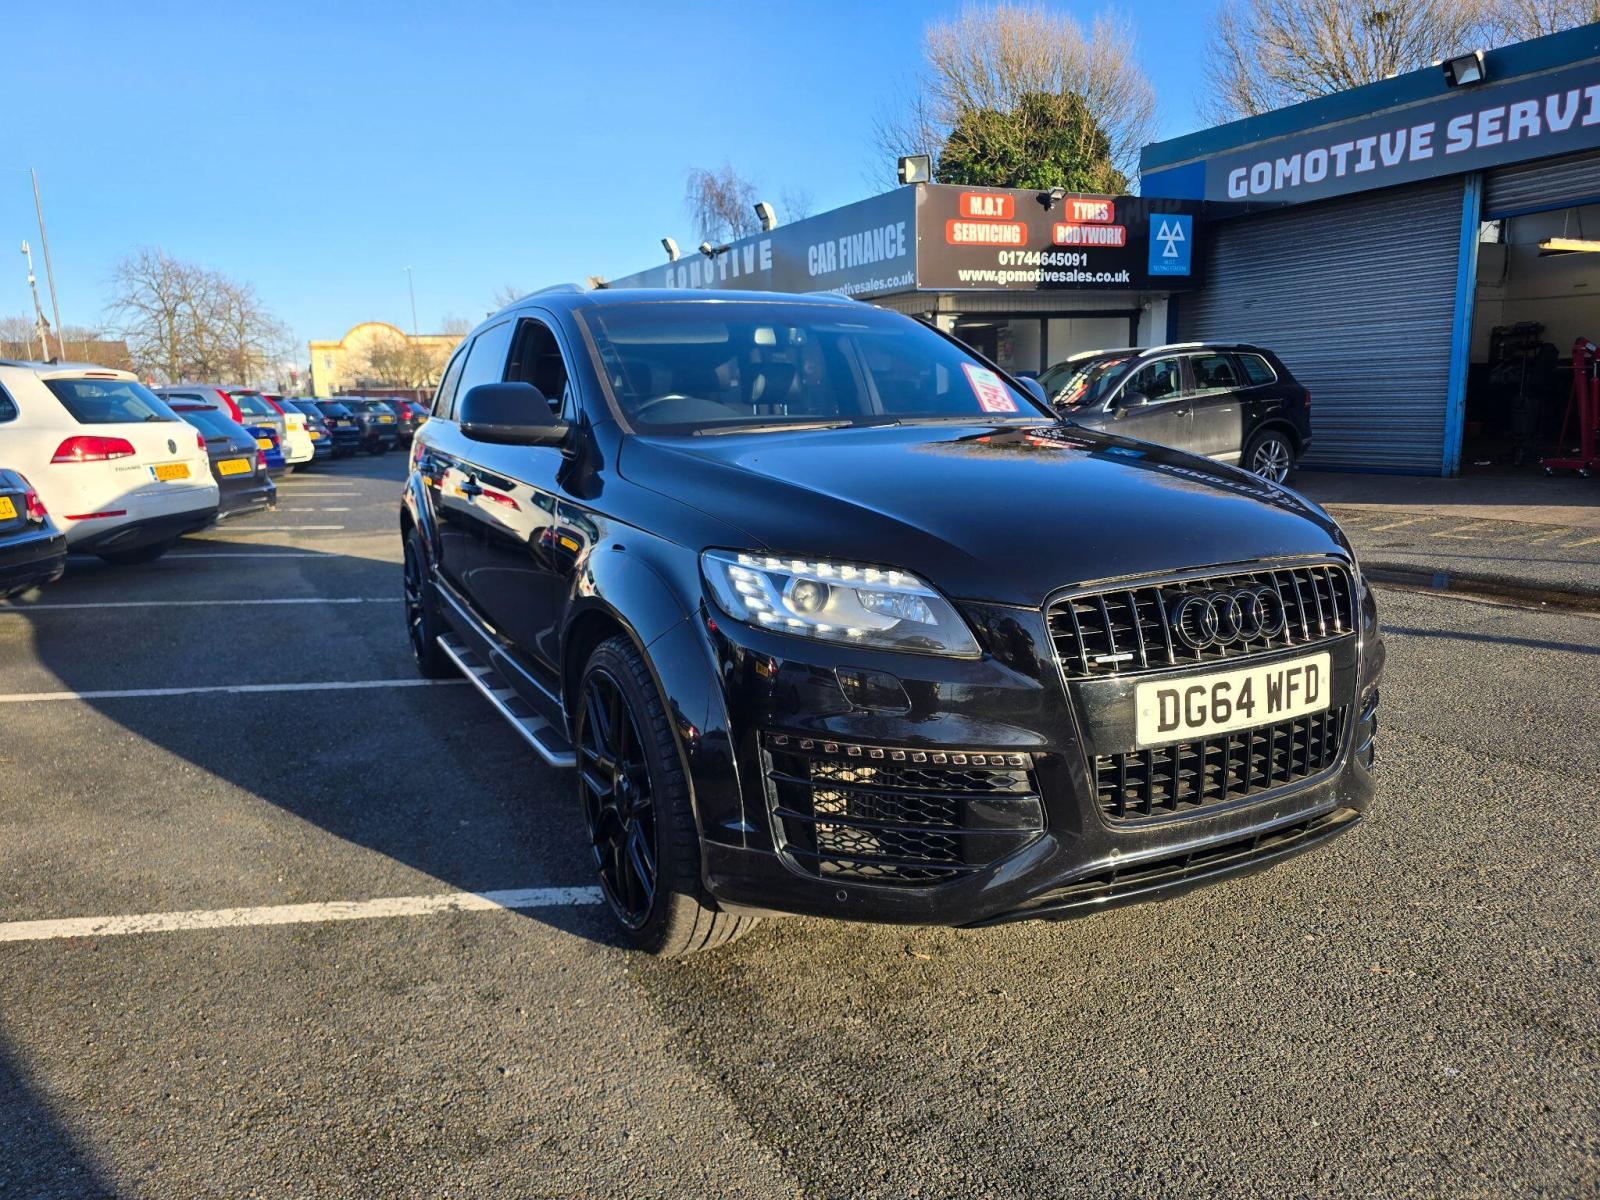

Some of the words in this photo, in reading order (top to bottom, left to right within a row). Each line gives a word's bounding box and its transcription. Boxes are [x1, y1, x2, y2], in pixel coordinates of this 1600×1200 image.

[1228, 122, 1435, 199] GOMOTIVE
[969, 197, 1004, 216] M.O.T
[1072, 202, 1109, 221] TYRES
[953, 223, 1021, 244] SERVICING
[1056, 225, 1123, 245] BODYWORK
[808, 244, 836, 277] CAR
[839, 221, 906, 270] FINANCE
[998, 250, 1088, 267] 01744645091
[665, 238, 773, 289] GOMOTIVE
[958, 268, 1130, 284] www.gomotivesales.co.uk
[1157, 676, 1255, 733] DG64
[1266, 664, 1319, 714] WFD
